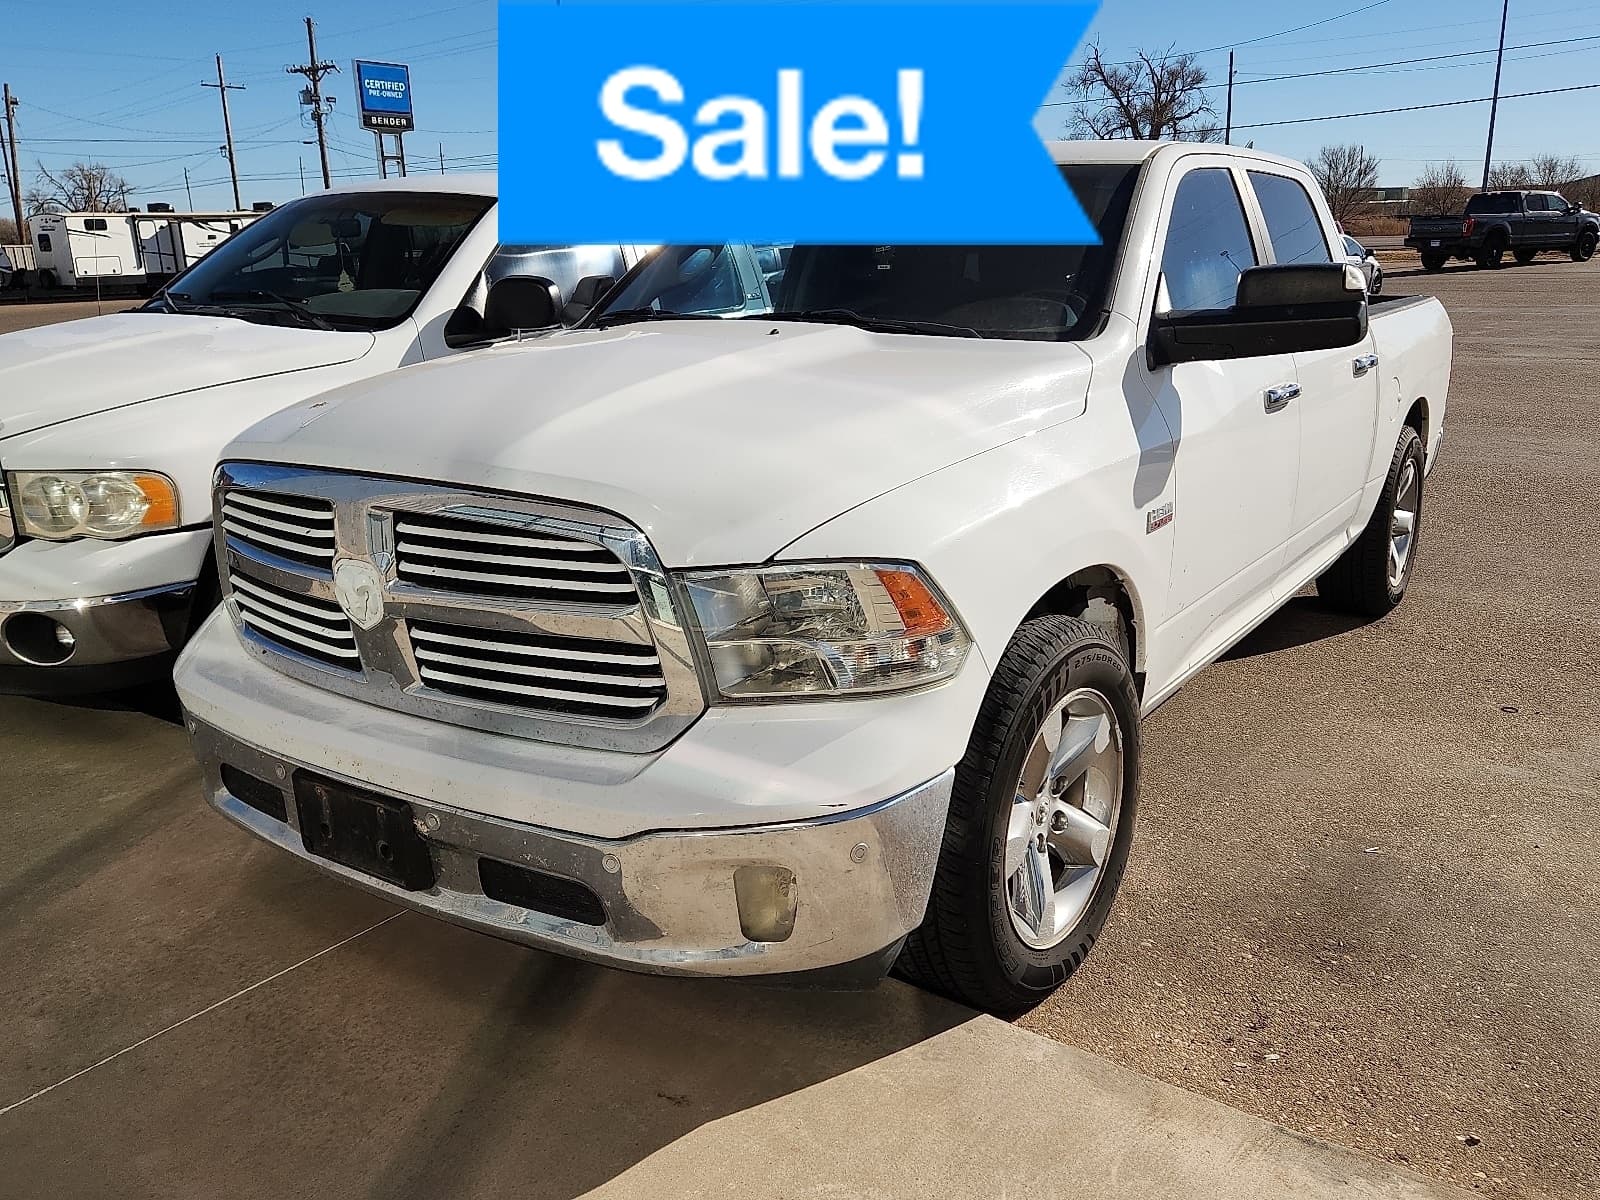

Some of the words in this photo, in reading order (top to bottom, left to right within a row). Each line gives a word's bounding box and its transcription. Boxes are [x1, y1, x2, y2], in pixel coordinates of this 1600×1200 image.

[364, 79, 406, 91] CERTIFIED
[368, 89, 403, 99] PRE-OWNED
[371, 116, 407, 126] BENDER
